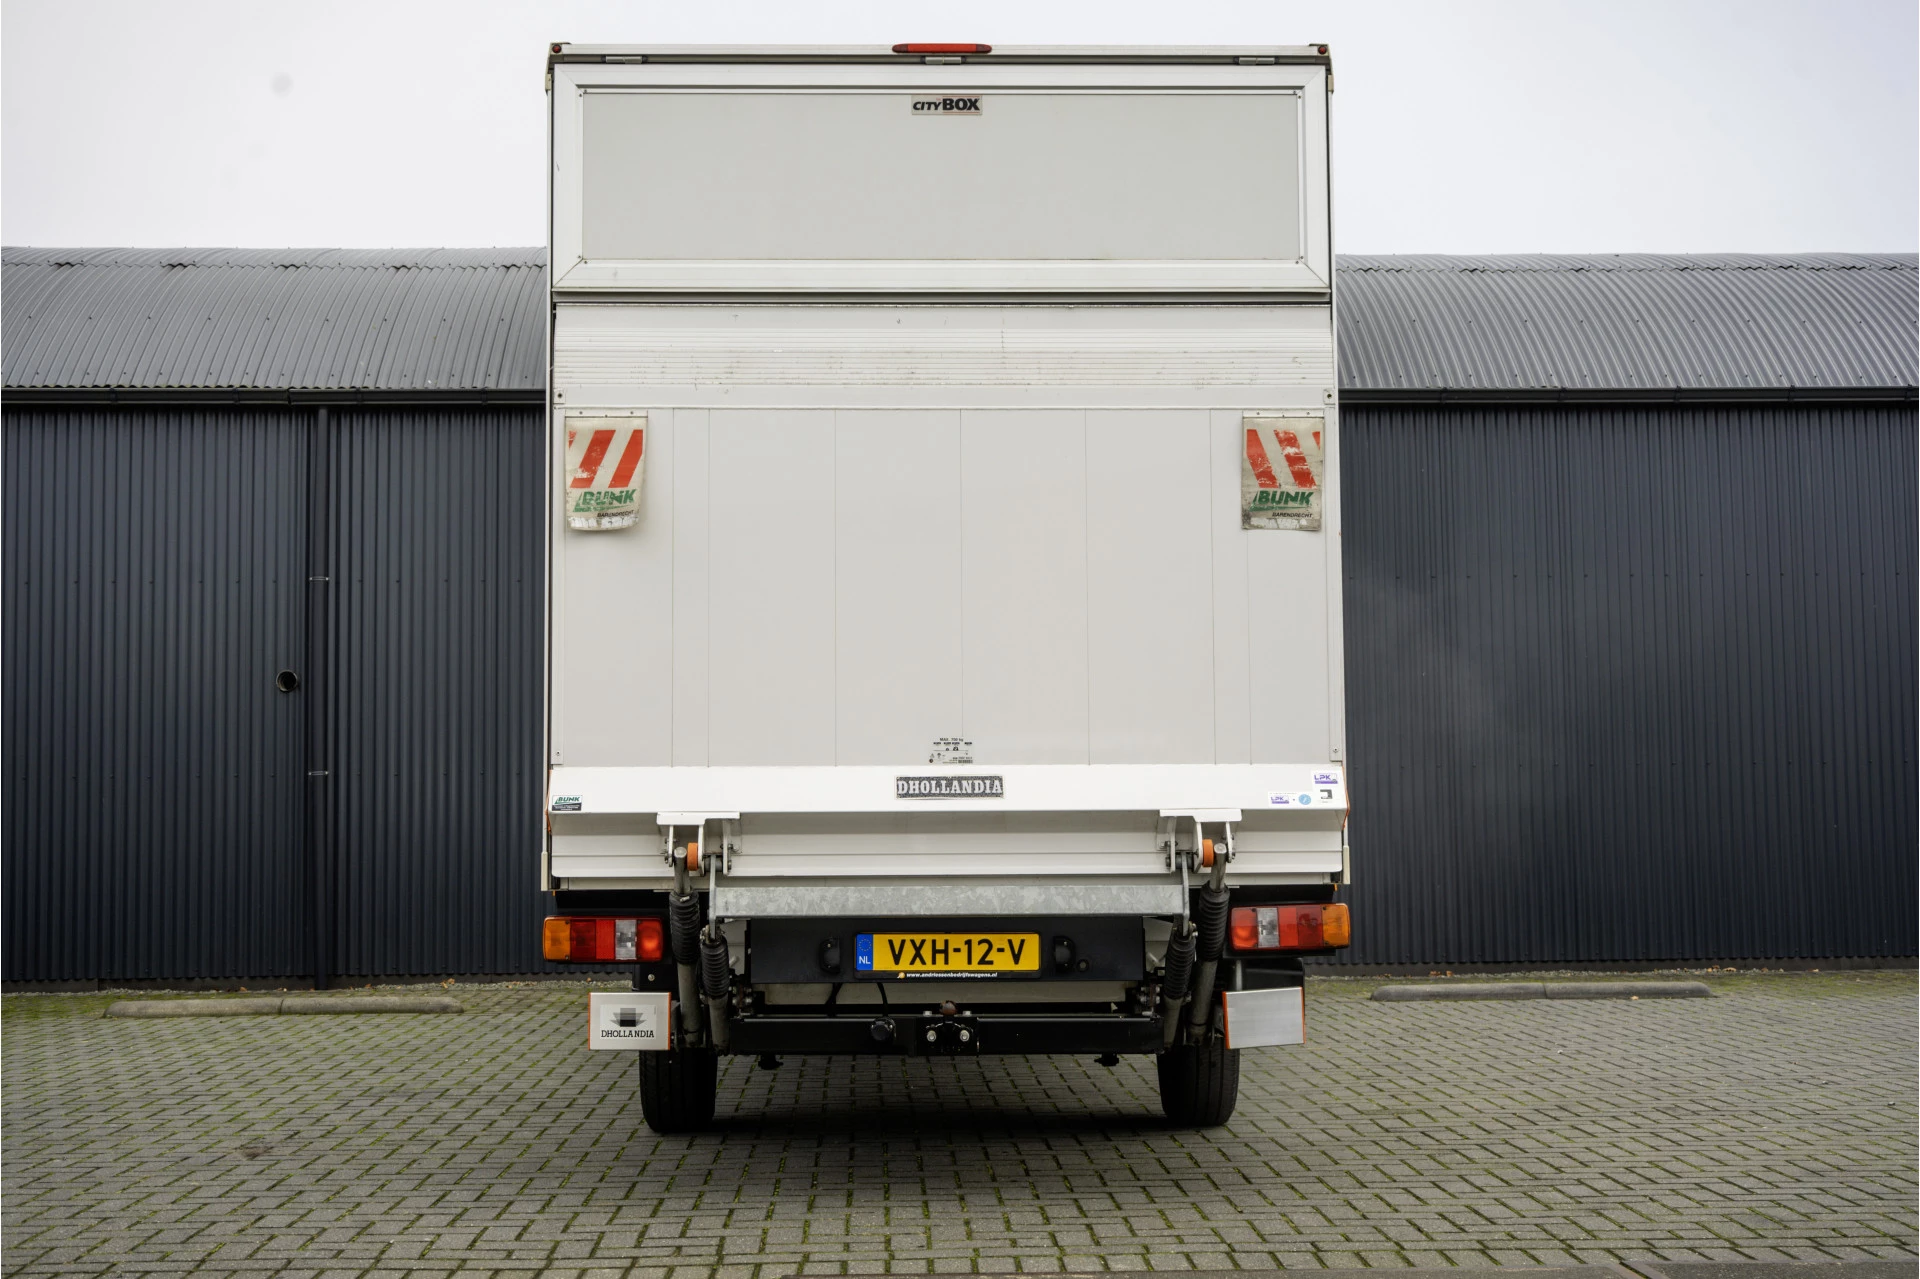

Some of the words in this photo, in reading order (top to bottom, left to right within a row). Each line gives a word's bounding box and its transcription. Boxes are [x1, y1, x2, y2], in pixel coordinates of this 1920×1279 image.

[581, 489, 637, 506] BUNK
[1257, 490, 1314, 506] BUNK
[897, 780, 1003, 795] DHOLLANDIA
[888, 938, 1026, 966] VXH-12-V
[858, 955, 871, 965] NL
[601, 1029, 655, 1038] DHOLLANDIA
